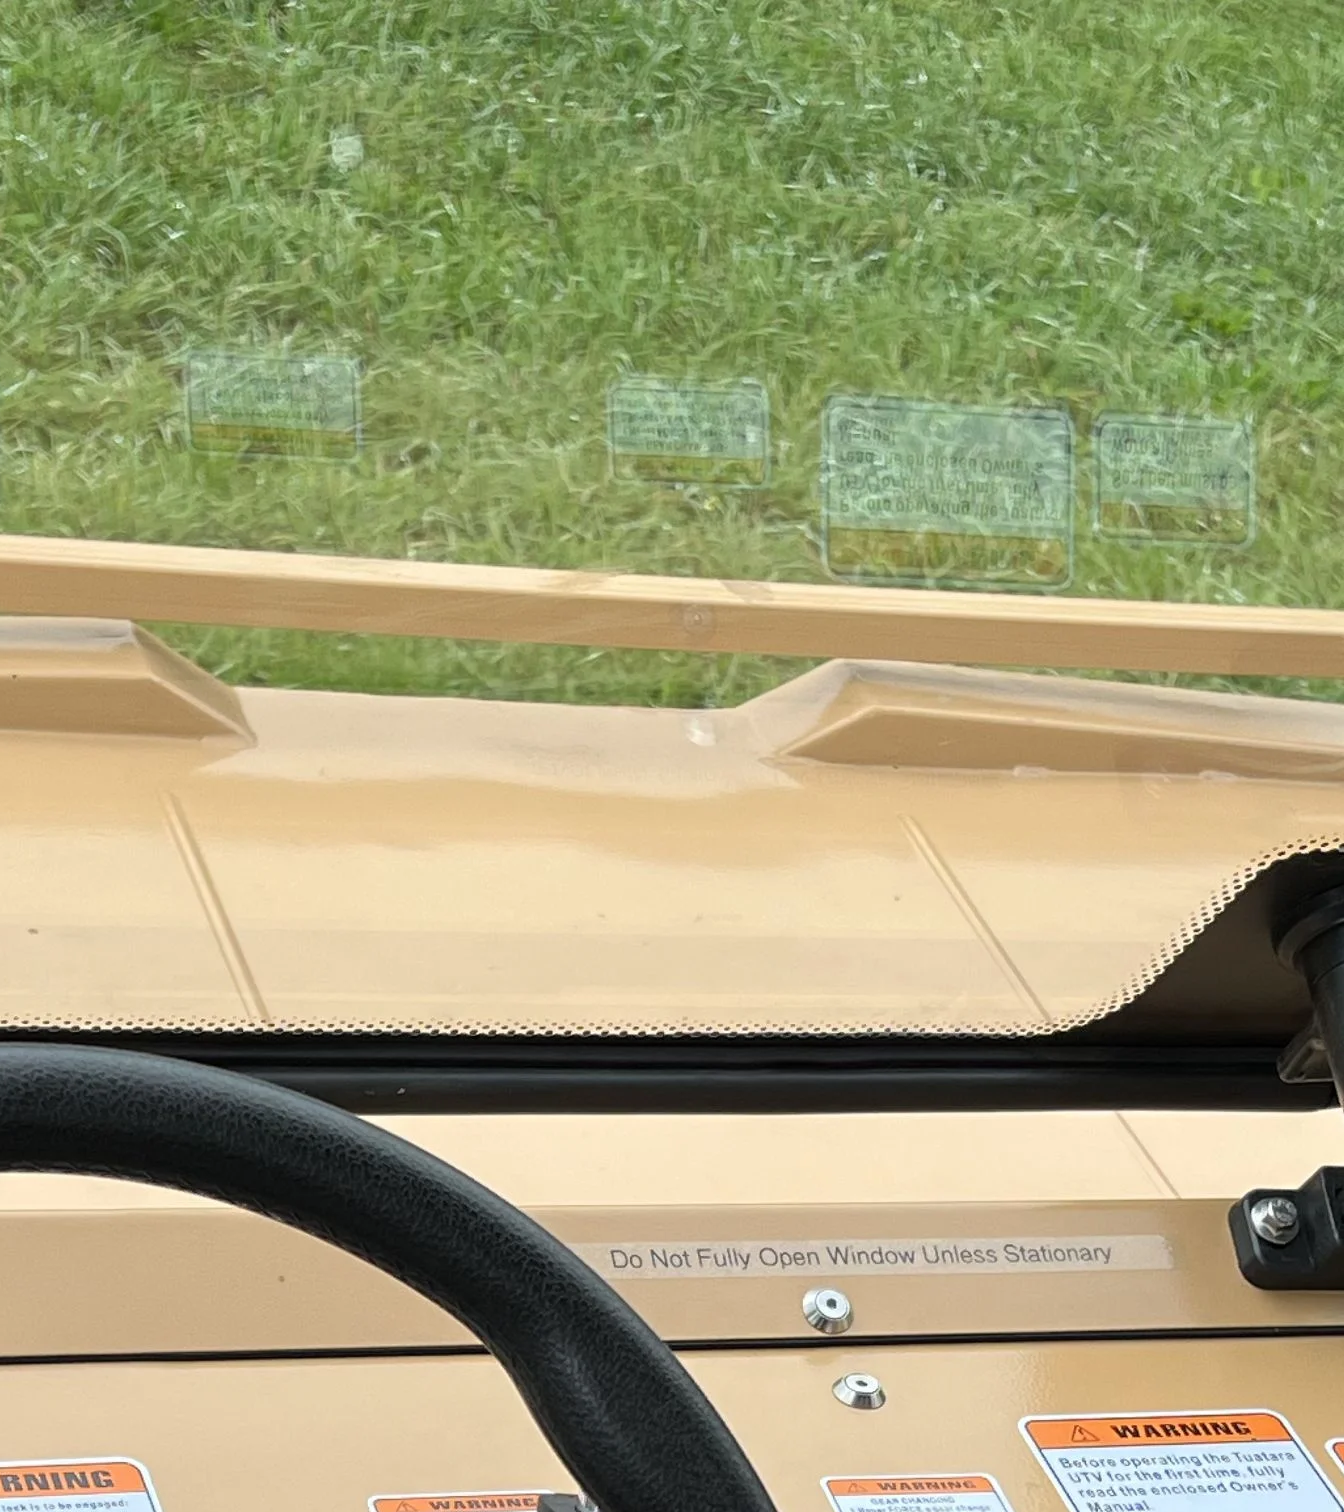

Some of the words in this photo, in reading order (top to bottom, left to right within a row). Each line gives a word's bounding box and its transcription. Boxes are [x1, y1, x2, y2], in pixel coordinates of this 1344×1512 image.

[610, 1249, 642, 1269] Do
[650, 1248, 692, 1268] Not
[697, 1247, 751, 1270] Fully
[759, 1247, 820, 1269] Open
[827, 1245, 915, 1266] Window
[922, 1244, 998, 1264] Unless
[1003, 1243, 1112, 1265] Stationary
[1110, 1420, 1252, 1439] WARNING
[1059, 1456, 1116, 1469] Before
[1120, 1453, 1201, 1469] operating
[1203, 1451, 1229, 1464] the
[1231, 1449, 1296, 1463] Tuatara
[1069, 1471, 1103, 1484] UTV
[1107, 1470, 1132, 1482] for
[1135, 1469, 1162, 1482] the
[1164, 1467, 1201, 1480] first
[1247, 1465, 1285, 1480] fully
[877, 1480, 976, 1491] WARNING
[1078, 1485, 1116, 1498] read
[1119, 1484, 1147, 1497] the
[1152, 1481, 1227, 1495] enclosed
[1230, 1479, 1298, 1494] Owner's
